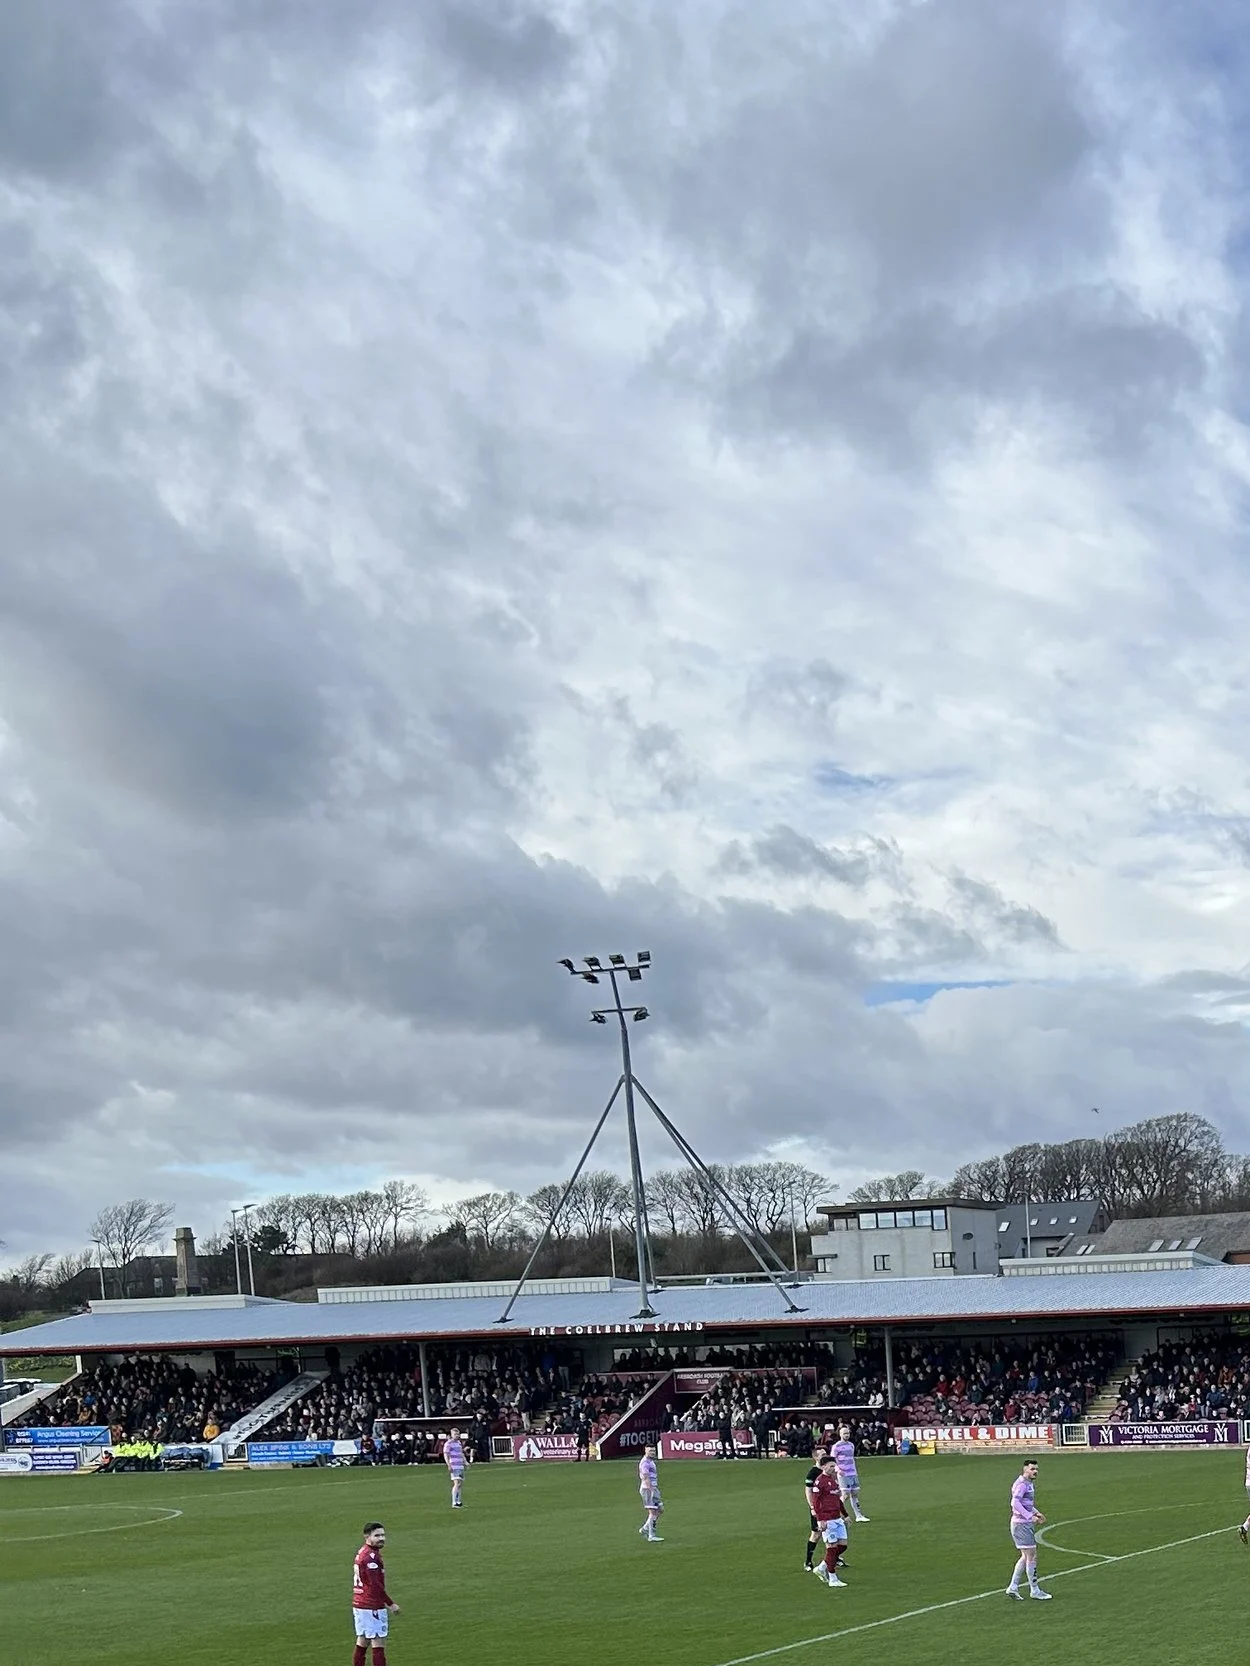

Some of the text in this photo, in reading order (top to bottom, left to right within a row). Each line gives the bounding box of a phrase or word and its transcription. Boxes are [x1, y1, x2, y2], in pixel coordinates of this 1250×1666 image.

[530, 1322, 704, 1336] THE COELBREW STAND
[902, 1426, 1048, 1441] NICKEL & DIME
[1118, 1425, 1158, 1434] VICTORIA
[1161, 1424, 1209, 1433] MORTGAGE
